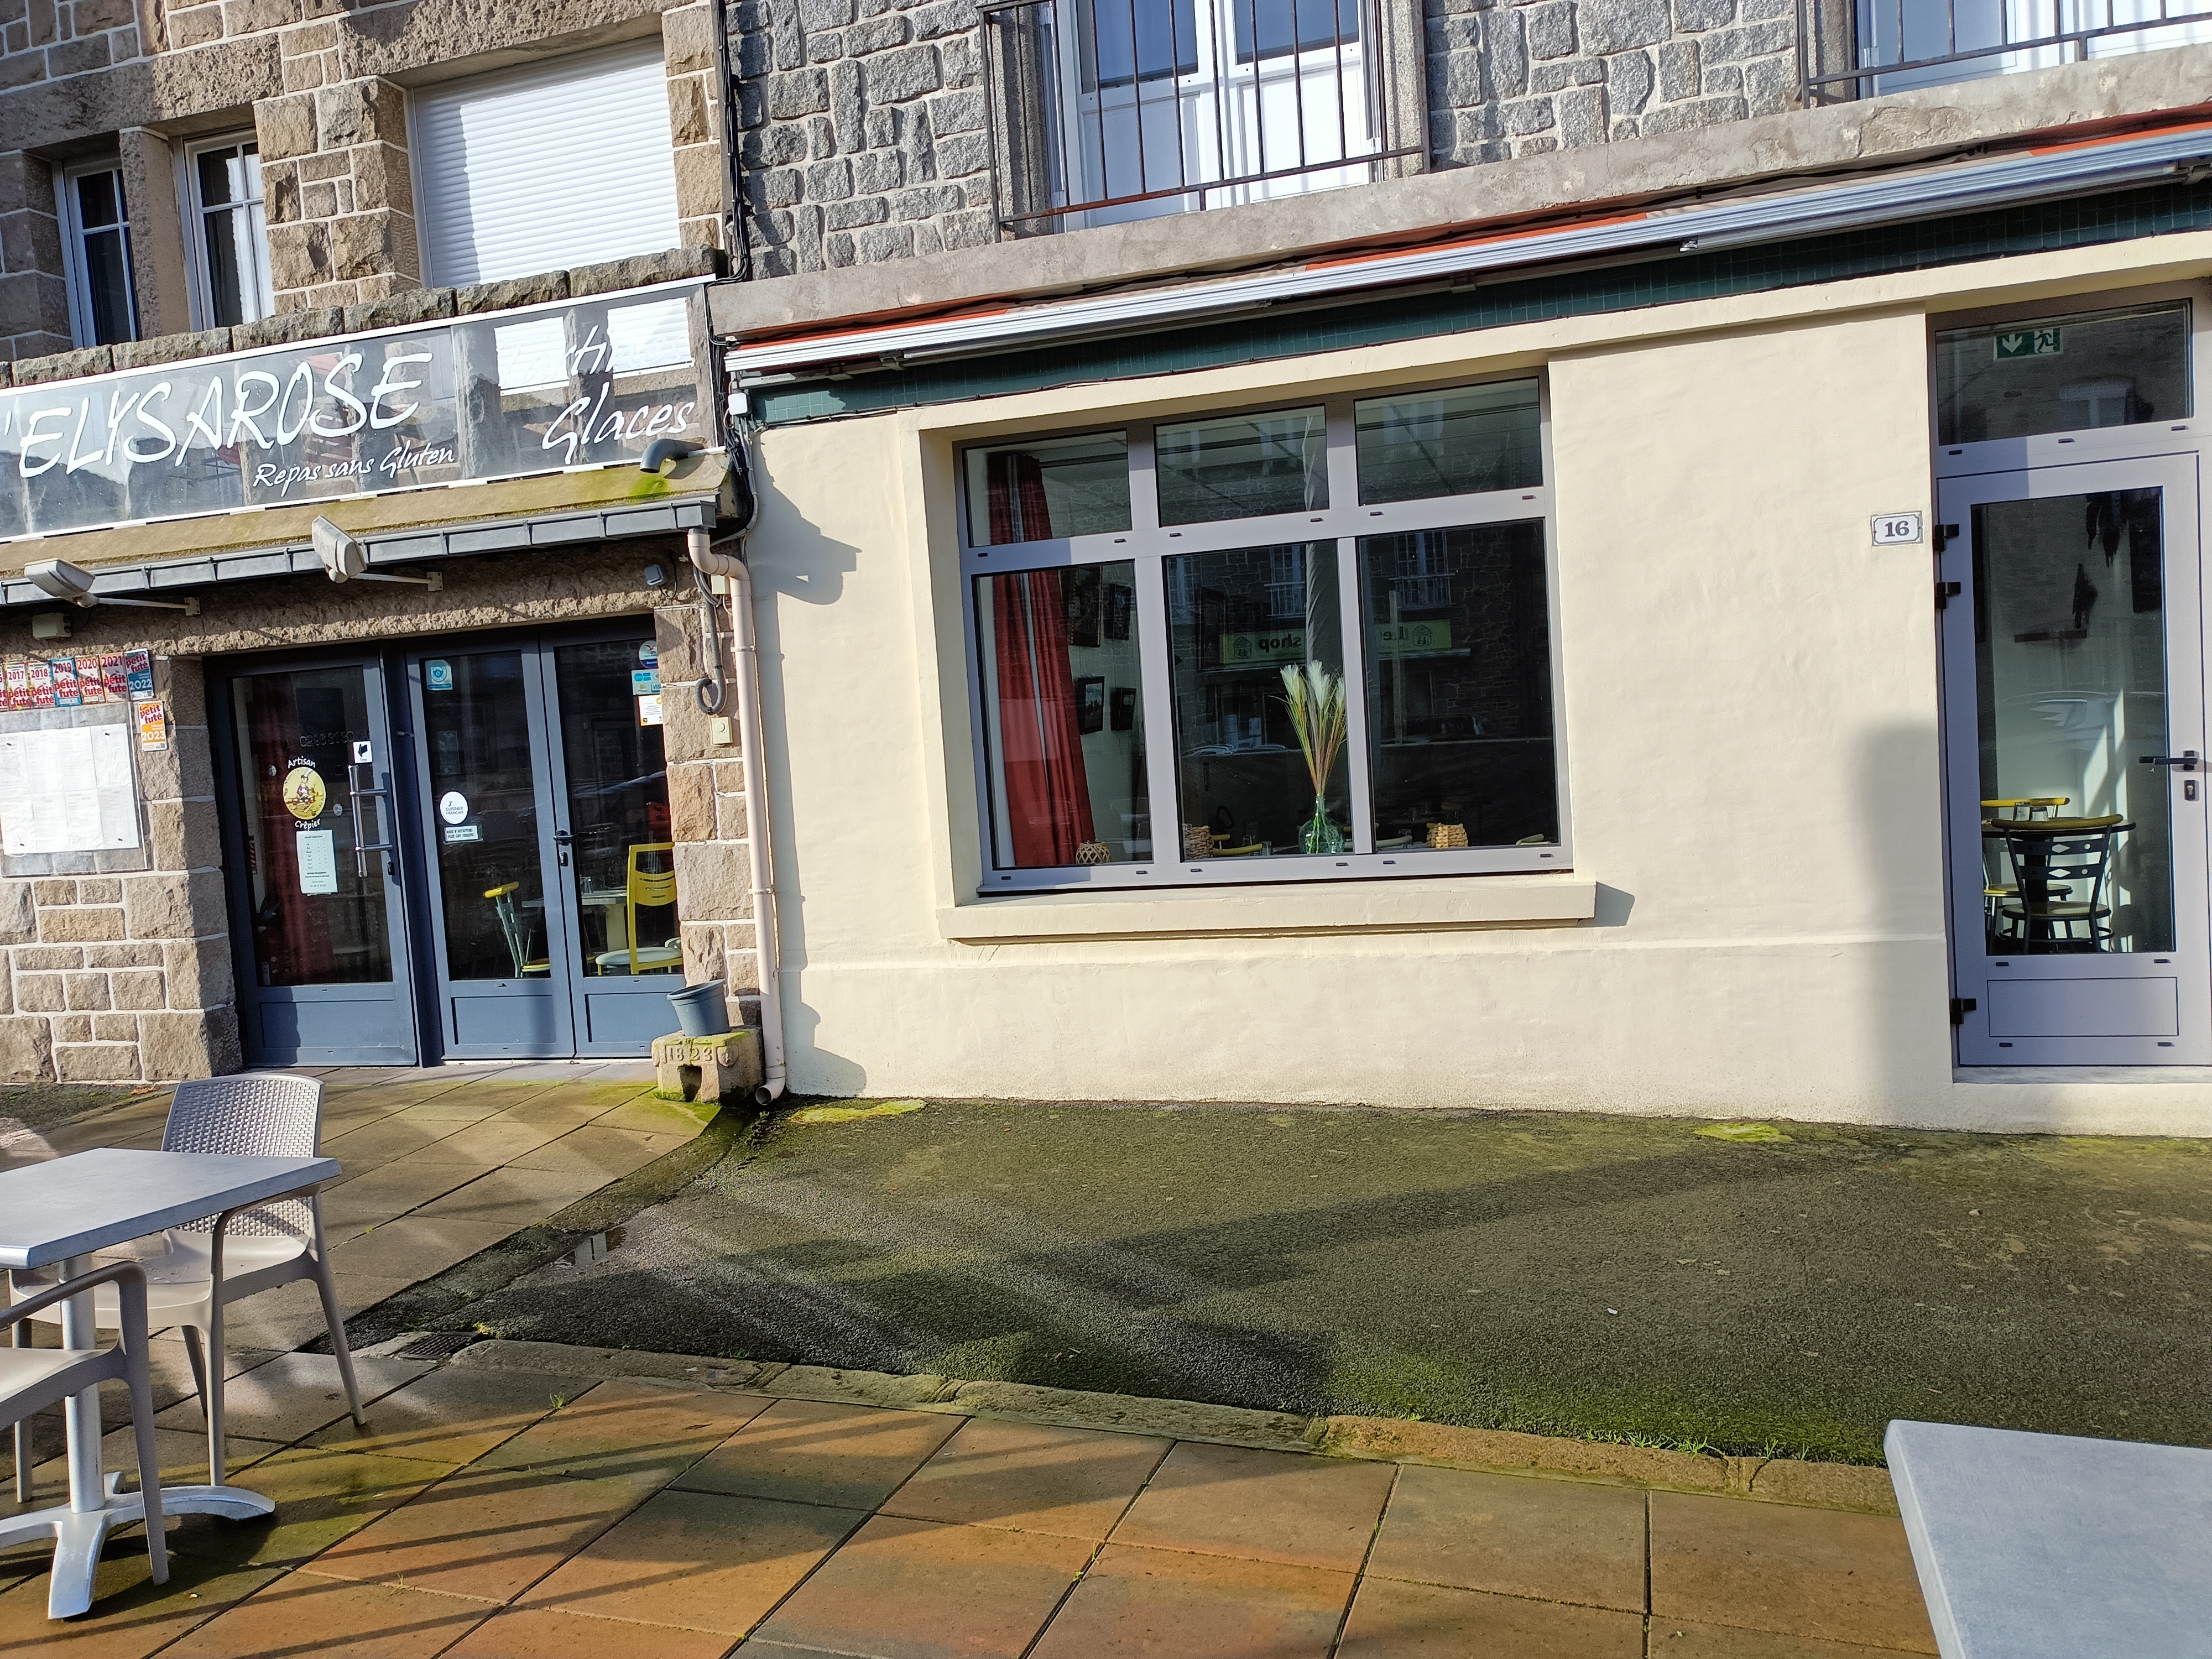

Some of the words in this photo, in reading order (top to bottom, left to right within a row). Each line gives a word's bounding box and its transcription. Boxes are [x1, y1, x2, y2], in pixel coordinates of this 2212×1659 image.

[4, 352, 434, 478] 'ELYSAROSE
[541, 382, 695, 465] Glaces
[253, 463, 321, 497] Repas
[325, 458, 375, 479] sans
[379, 440, 455, 478] Gluten
[1885, 520, 1910, 538] 16
[77, 658, 97, 670] 2020
[101, 655, 123, 668] 2021
[126, 653, 146, 668] petit
[31, 668, 48, 678] 2018
[54, 662, 72, 674] 2019
[131, 661, 148, 673] futé
[8, 670, 24, 681] 2017
[104, 674, 126, 687] petit
[54, 679, 77, 691] petit
[80, 677, 101, 688] petit
[129, 678, 152, 690] 2022
[8, 687, 31, 701] petit
[32, 686, 53, 698] petit
[36, 695, 55, 704] futé
[140, 704, 161, 719] petit
[144, 712, 163, 724] futé
[142, 730, 165, 741] 2023
[288, 756, 316, 769] Artisan
[295, 818, 321, 831] Crêpier
